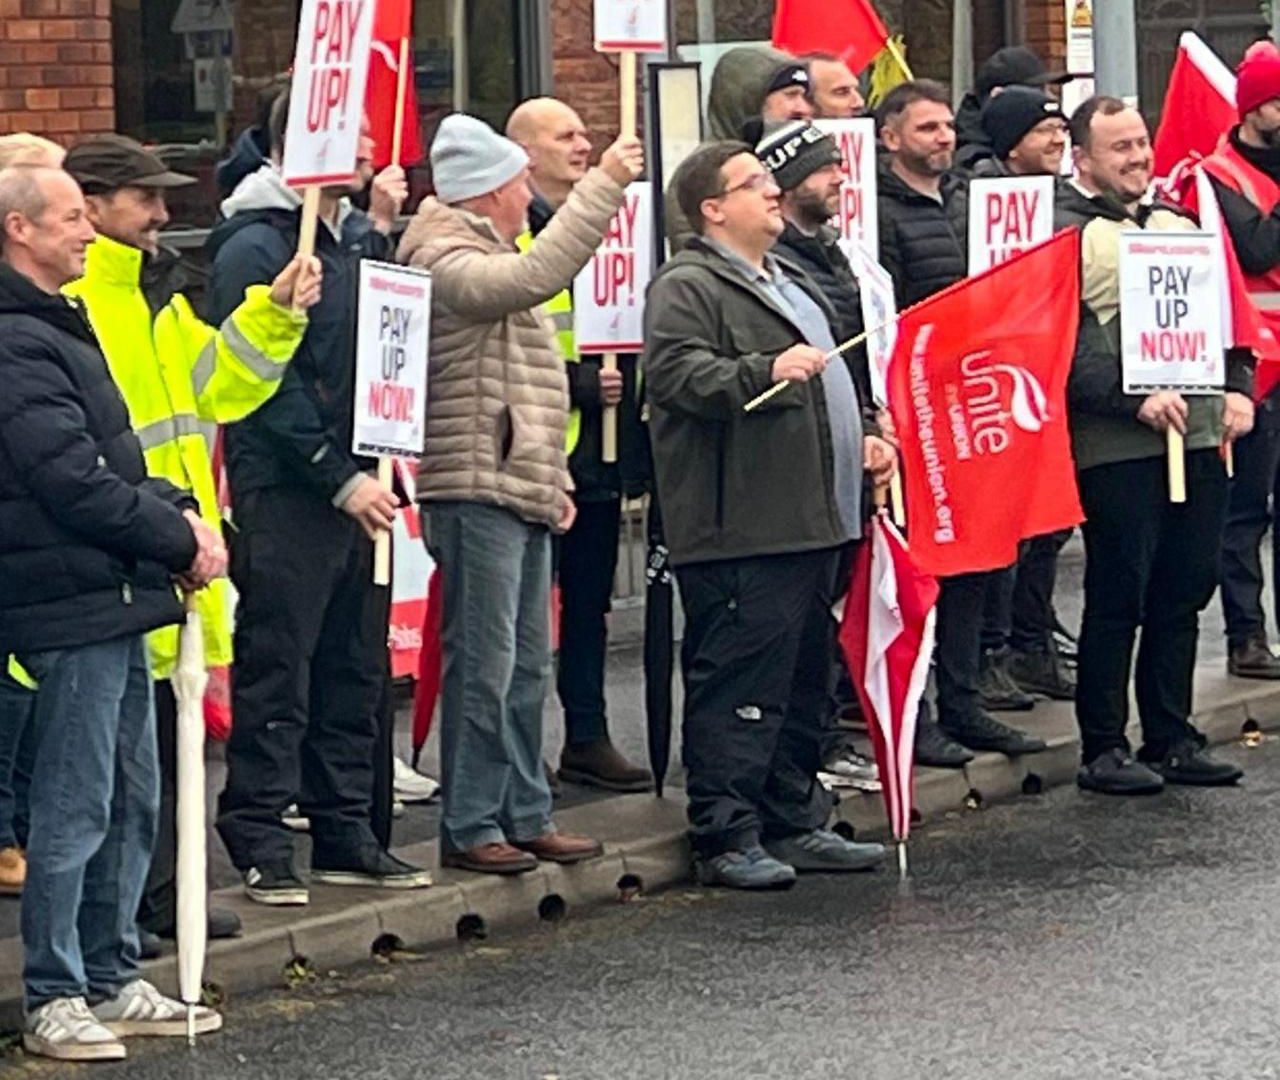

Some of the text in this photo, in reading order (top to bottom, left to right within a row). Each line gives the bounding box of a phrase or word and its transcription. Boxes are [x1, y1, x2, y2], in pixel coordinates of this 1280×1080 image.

[306, 67, 353, 134] UP!
[841, 130, 864, 185] AY
[603, 193, 640, 249] AY
[842, 187, 864, 240] P!
[985, 189, 1041, 245] PAY
[594, 251, 636, 308] UP!
[1148, 265, 1192, 297] PAY
[379, 304, 413, 345] PAY
[1155, 298, 1188, 329] UP
[381, 346, 407, 382] UP
[1139, 331, 1208, 363] NOW!
[367, 381, 417, 424] NOW!
[960, 350, 1010, 456] unite
[909, 322, 956, 546] www.unitetheunion.org
